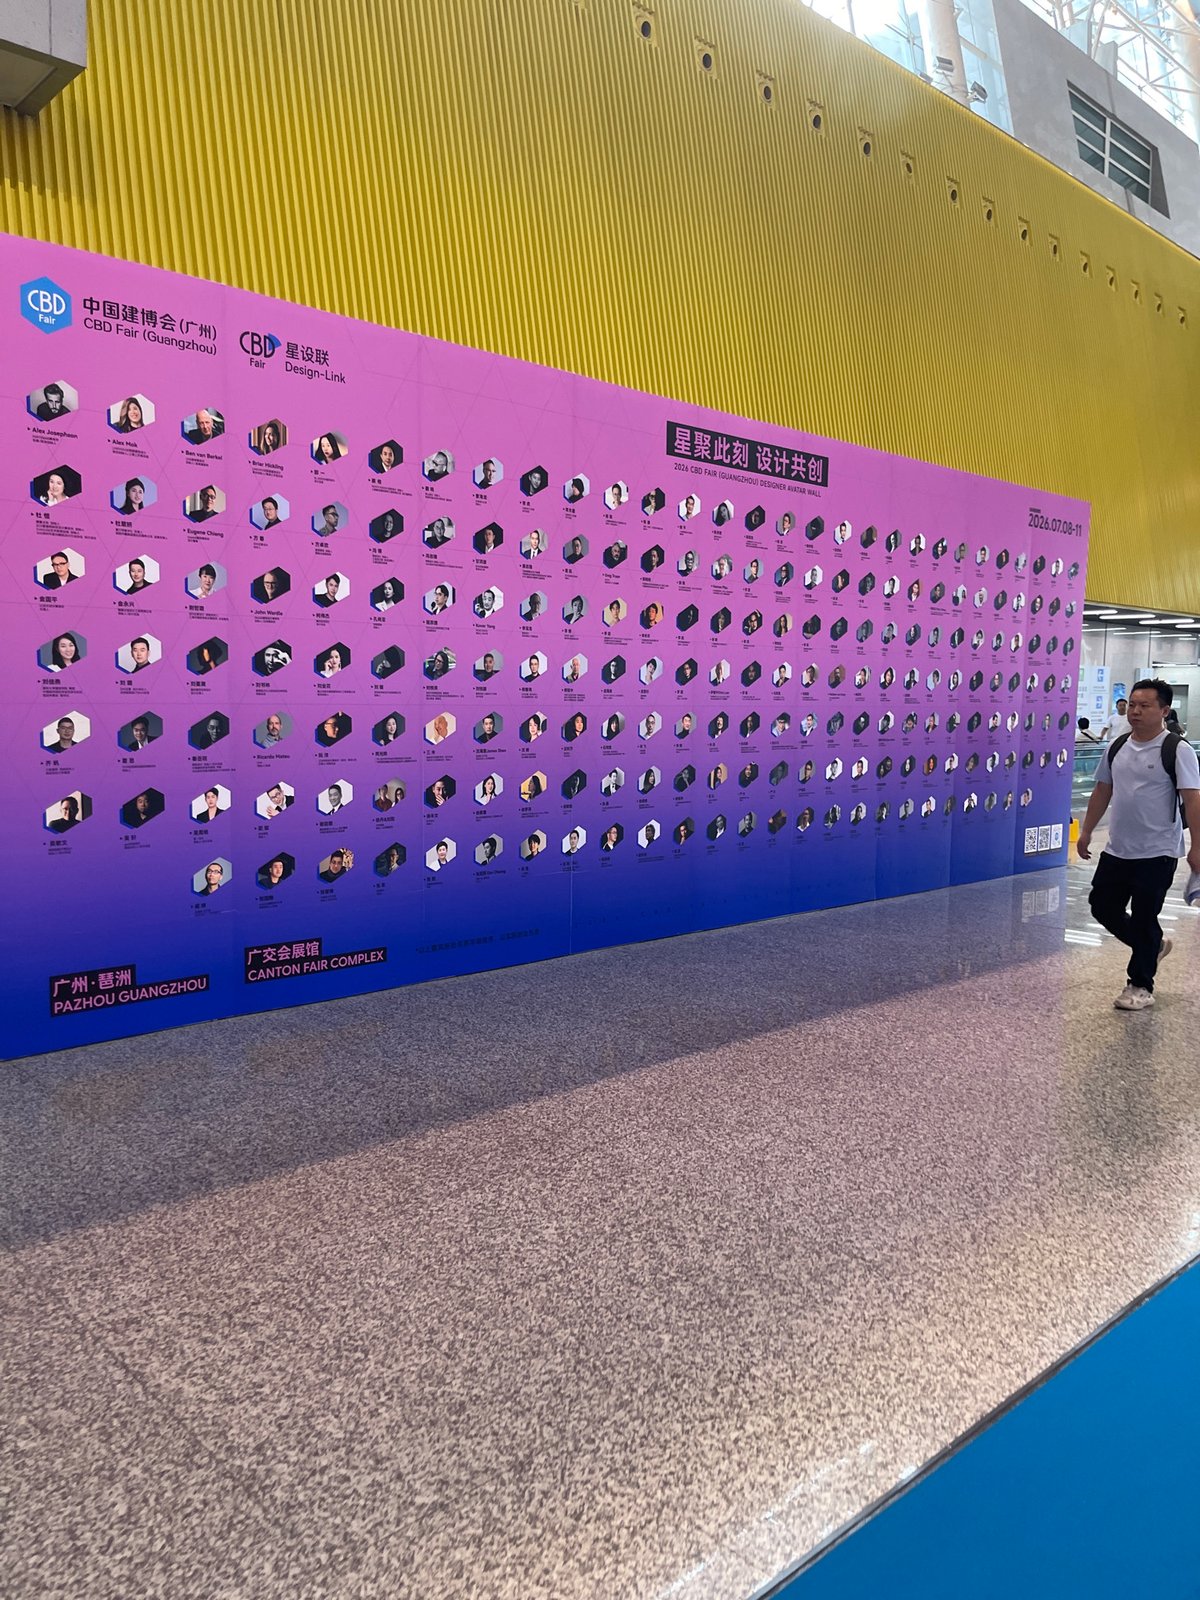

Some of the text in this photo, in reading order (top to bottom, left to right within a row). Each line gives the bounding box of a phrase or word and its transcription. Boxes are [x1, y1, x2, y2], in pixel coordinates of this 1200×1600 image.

[27, 289, 66, 315] CBD
[38, 313, 56, 325] Fair
[83, 317, 217, 356] CBD Fair (Guangzhou)
[239, 331, 276, 359] CBD
[249, 357, 266, 369] Fair
[285, 341, 330, 367] 星设联
[285, 361, 346, 384] Design-Link
[32, 427, 45, 435] Alex
[674, 427, 823, 483] 星聚此刻 设计共创
[674, 462, 822, 498] 2026 CBD FAIR (GUANGZHOU) DESIGNER AVATAR WALL
[187, 528, 206, 537] Eugene
[1028, 513, 1082, 537] 2026.07.08-11
[247, 940, 320, 965] 广交会展馆
[247, 949, 385, 982] CANTON FAIR COMPLEX
[53, 968, 132, 998] 广州·琶洲
[53, 977, 207, 1015] PAZHOU GUANGZHOU
